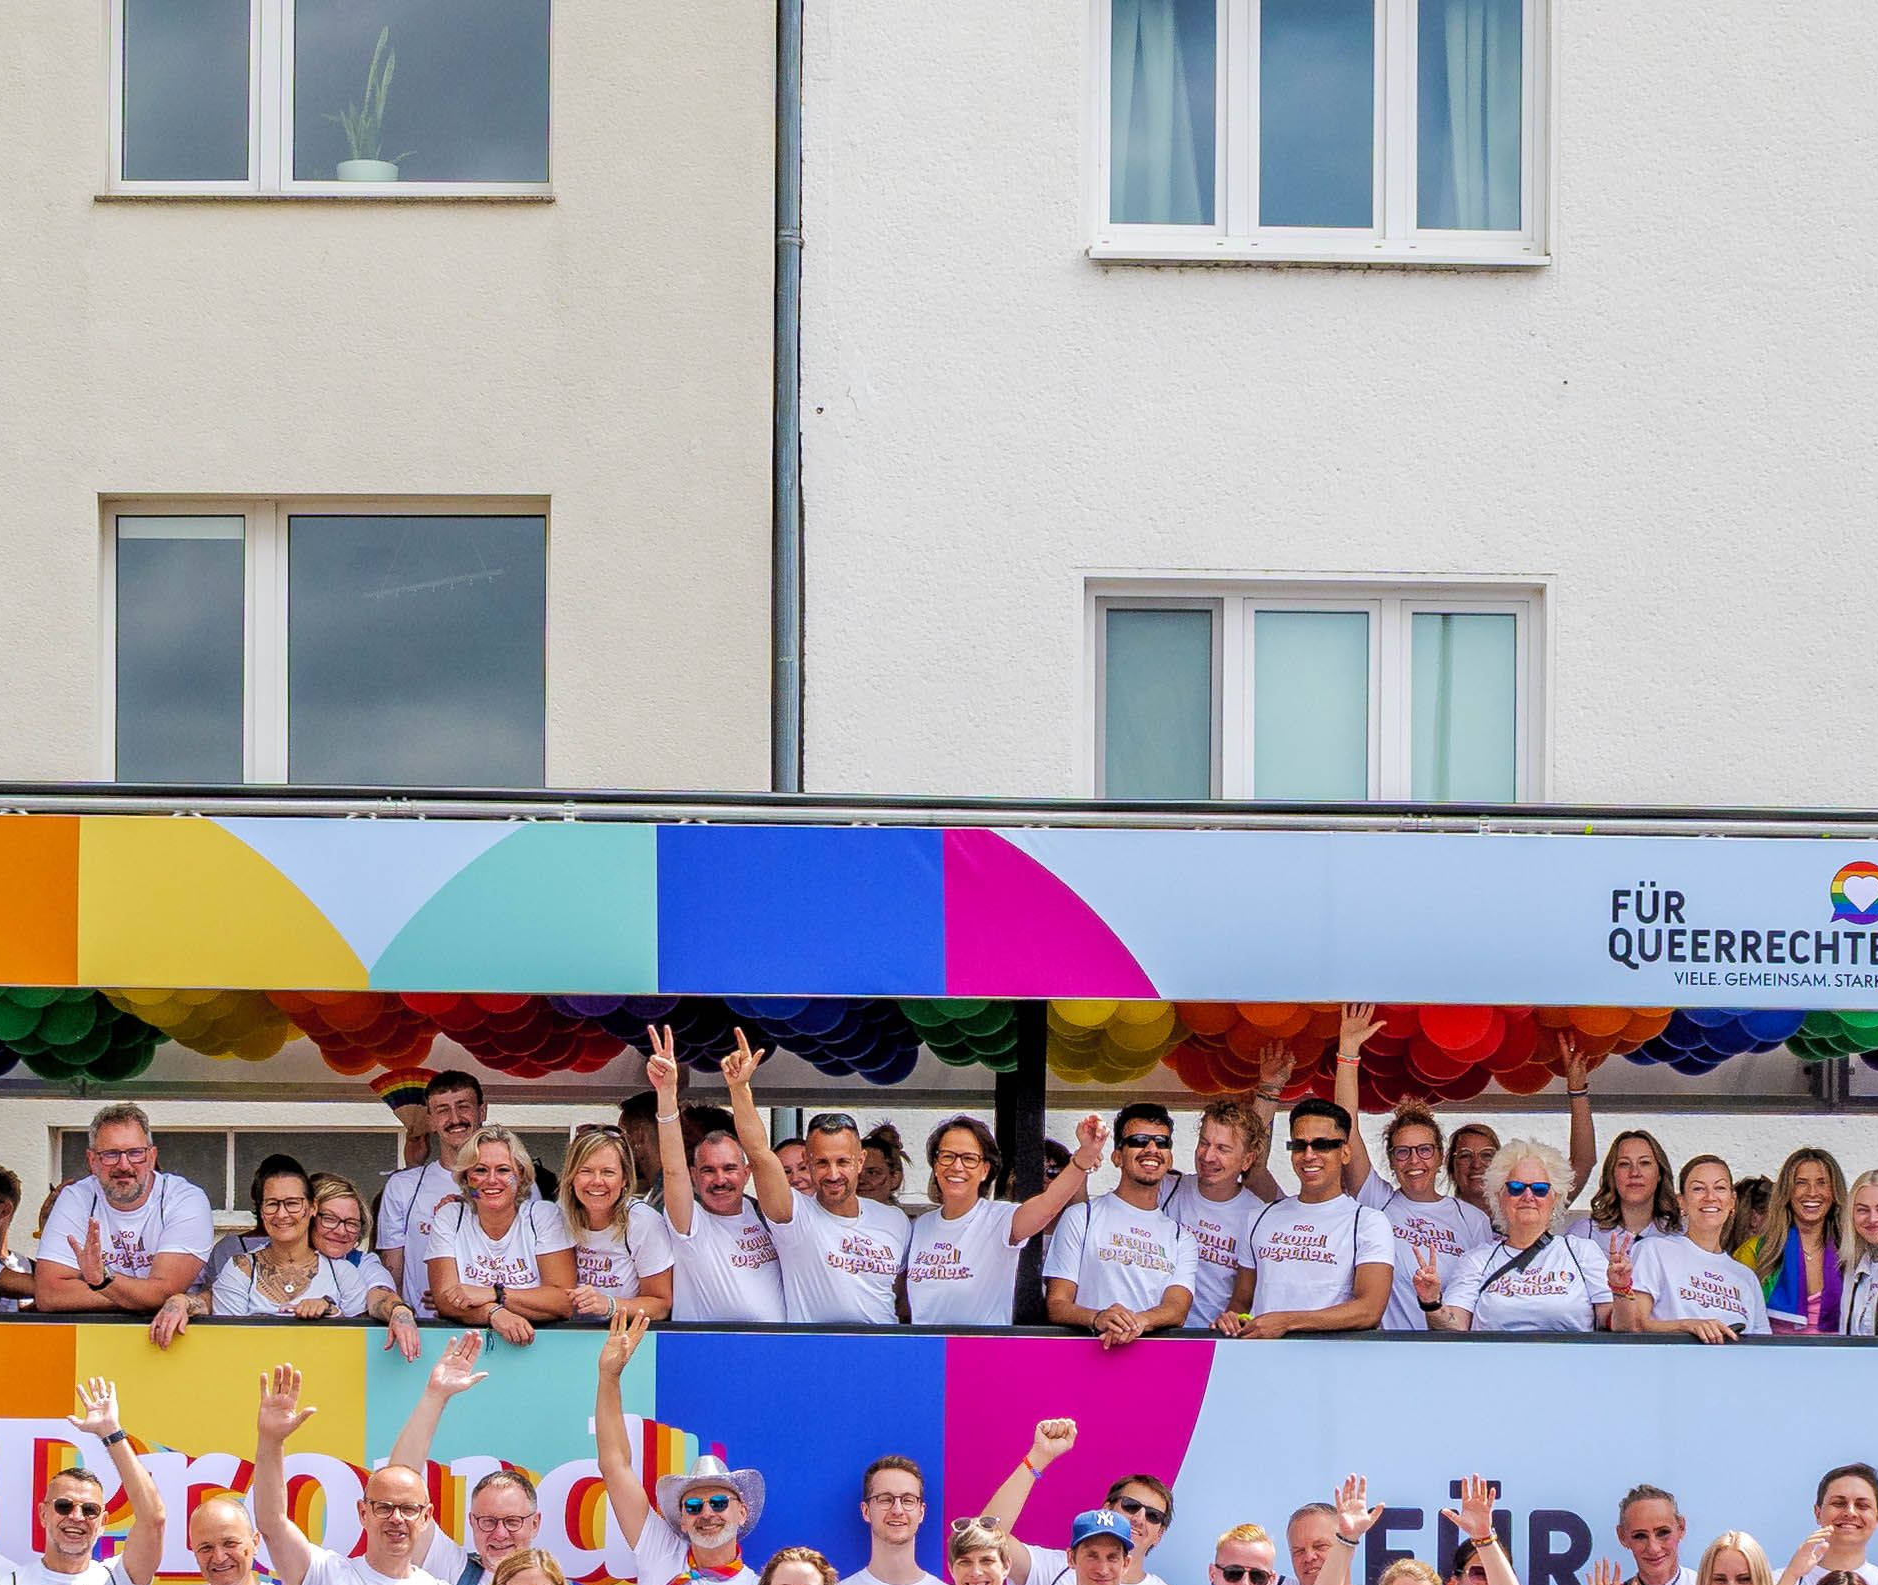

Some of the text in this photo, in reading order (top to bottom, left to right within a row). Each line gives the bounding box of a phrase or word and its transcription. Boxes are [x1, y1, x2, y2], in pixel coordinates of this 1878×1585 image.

[1611, 880, 1686, 924] FÜR
[1674, 971, 1721, 986] VIELE.
[1724, 972, 1831, 988] GEMEINSAM.
